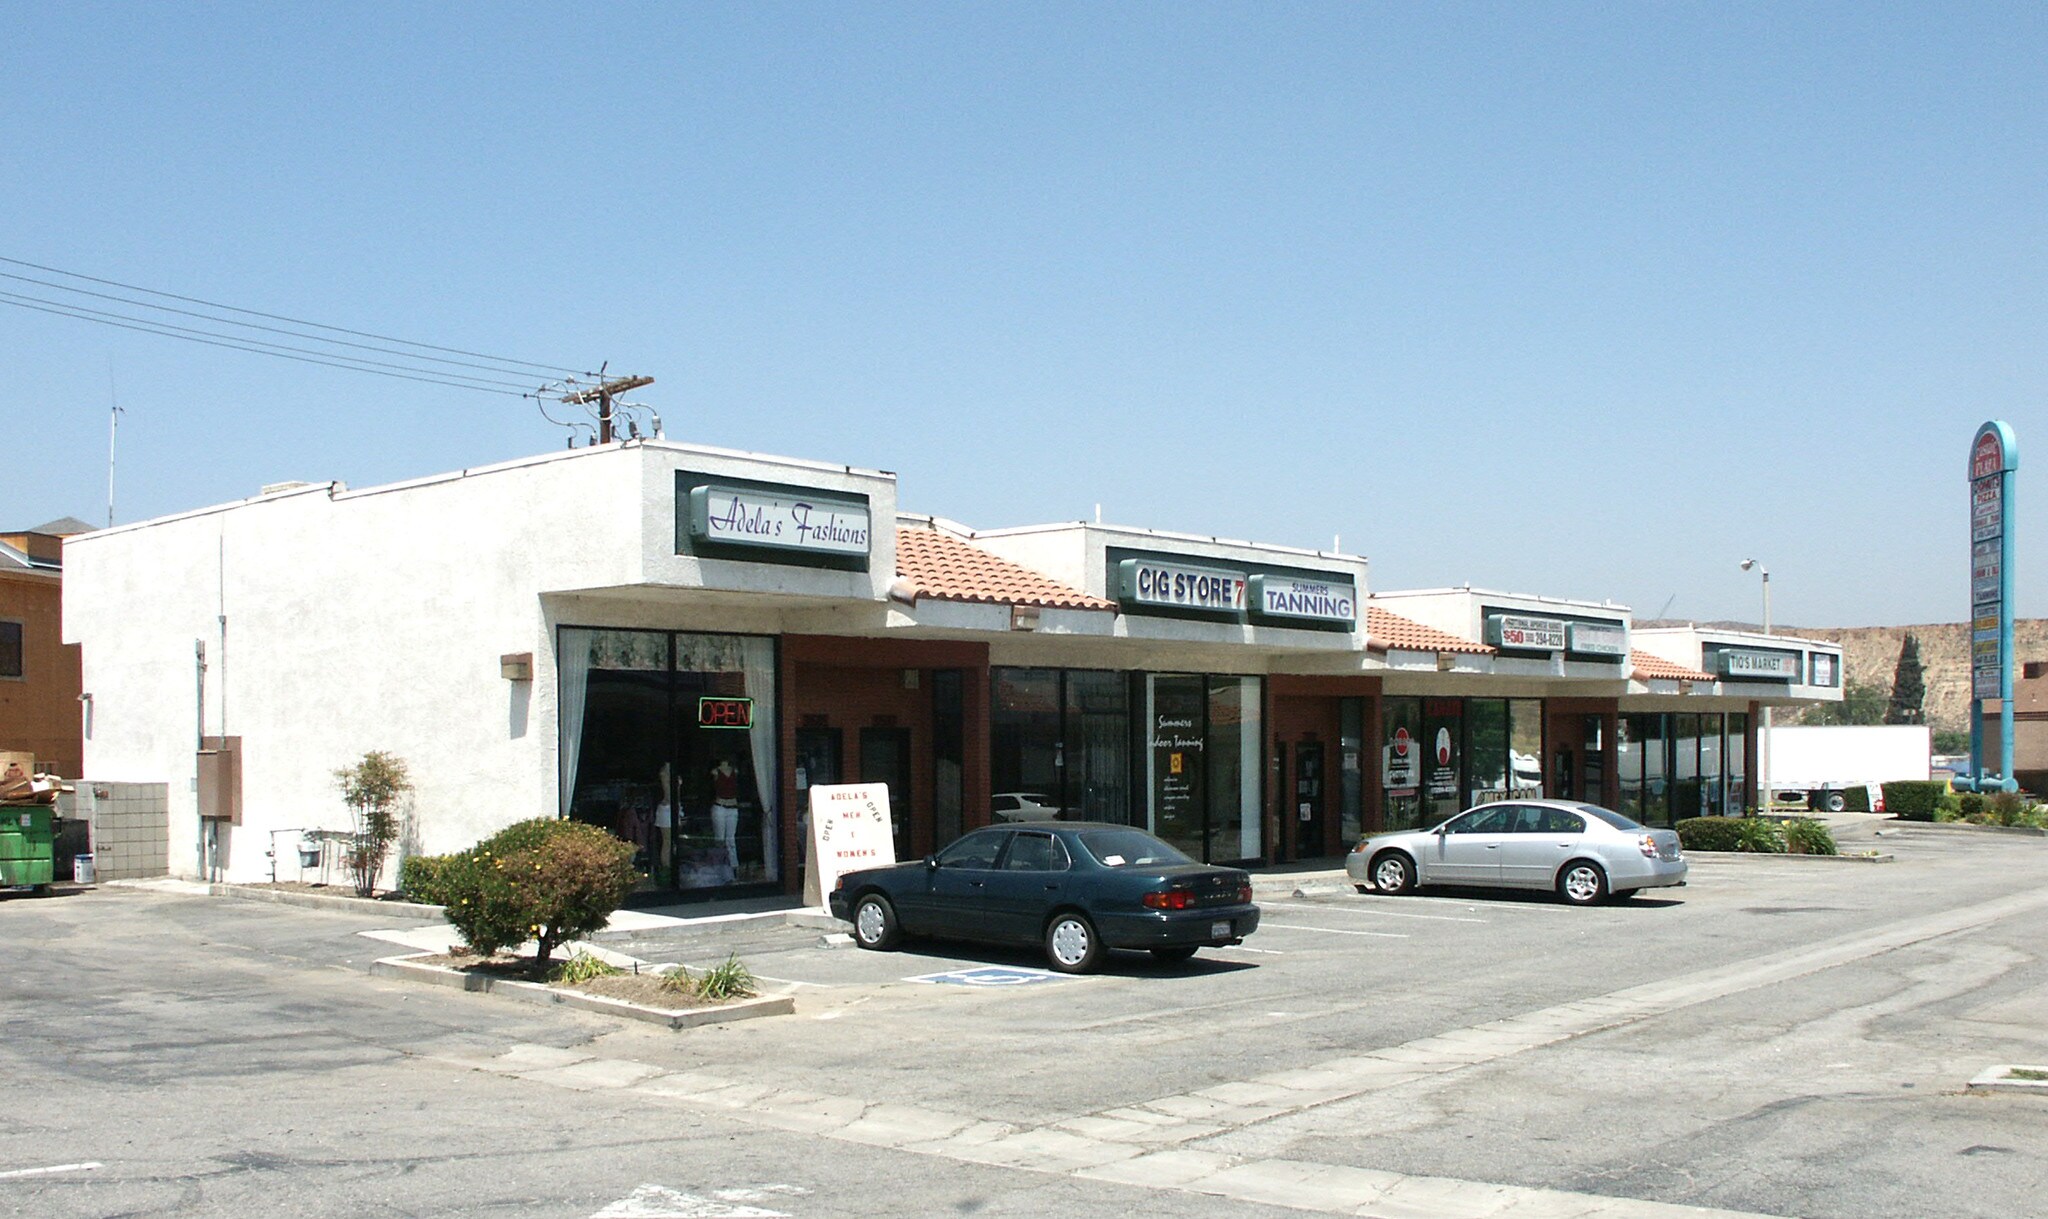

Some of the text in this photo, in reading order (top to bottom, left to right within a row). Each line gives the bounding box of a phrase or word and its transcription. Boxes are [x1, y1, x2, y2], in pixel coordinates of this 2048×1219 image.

[709, 497, 867, 544] Adela's Fashions
[1139, 567, 1245, 604] CIG STORE 7
[1292, 582, 1328, 595] SUMMERS
[1266, 591, 1350, 617] TANNING
[1504, 630, 1524, 644] $50
[1752, 656, 1780, 671] MARKET
[701, 701, 750, 725] OPEN
[1158, 714, 1192, 728] Summers
[1174, 735, 1203, 752] Tanning
[831, 791, 868, 801] ADELA'S
[866, 801, 883, 823] OPEN
[822, 819, 834, 842] OPEN
